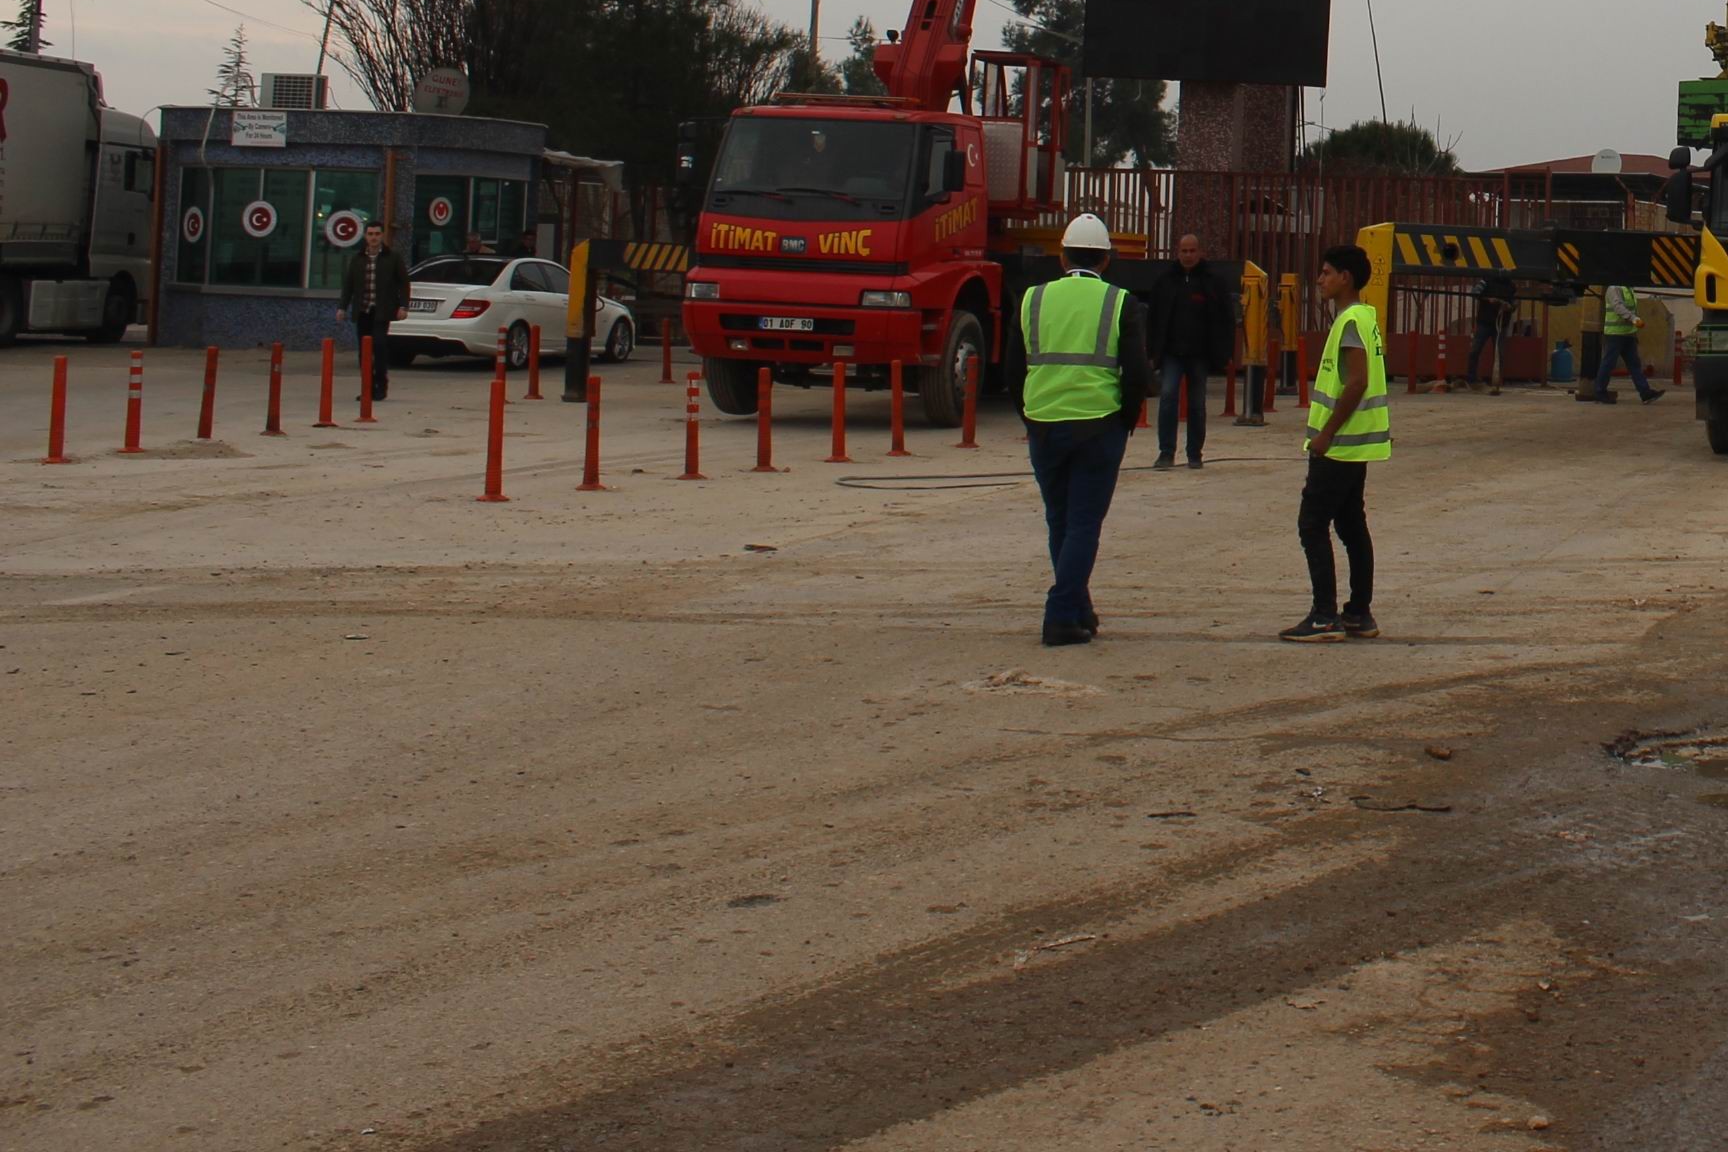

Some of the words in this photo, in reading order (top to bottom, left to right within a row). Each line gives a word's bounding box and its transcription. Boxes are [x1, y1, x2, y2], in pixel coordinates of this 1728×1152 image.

[781, 238, 805, 252] BMC
[763, 318, 774, 328] 01
[801, 319, 812, 330] 90
